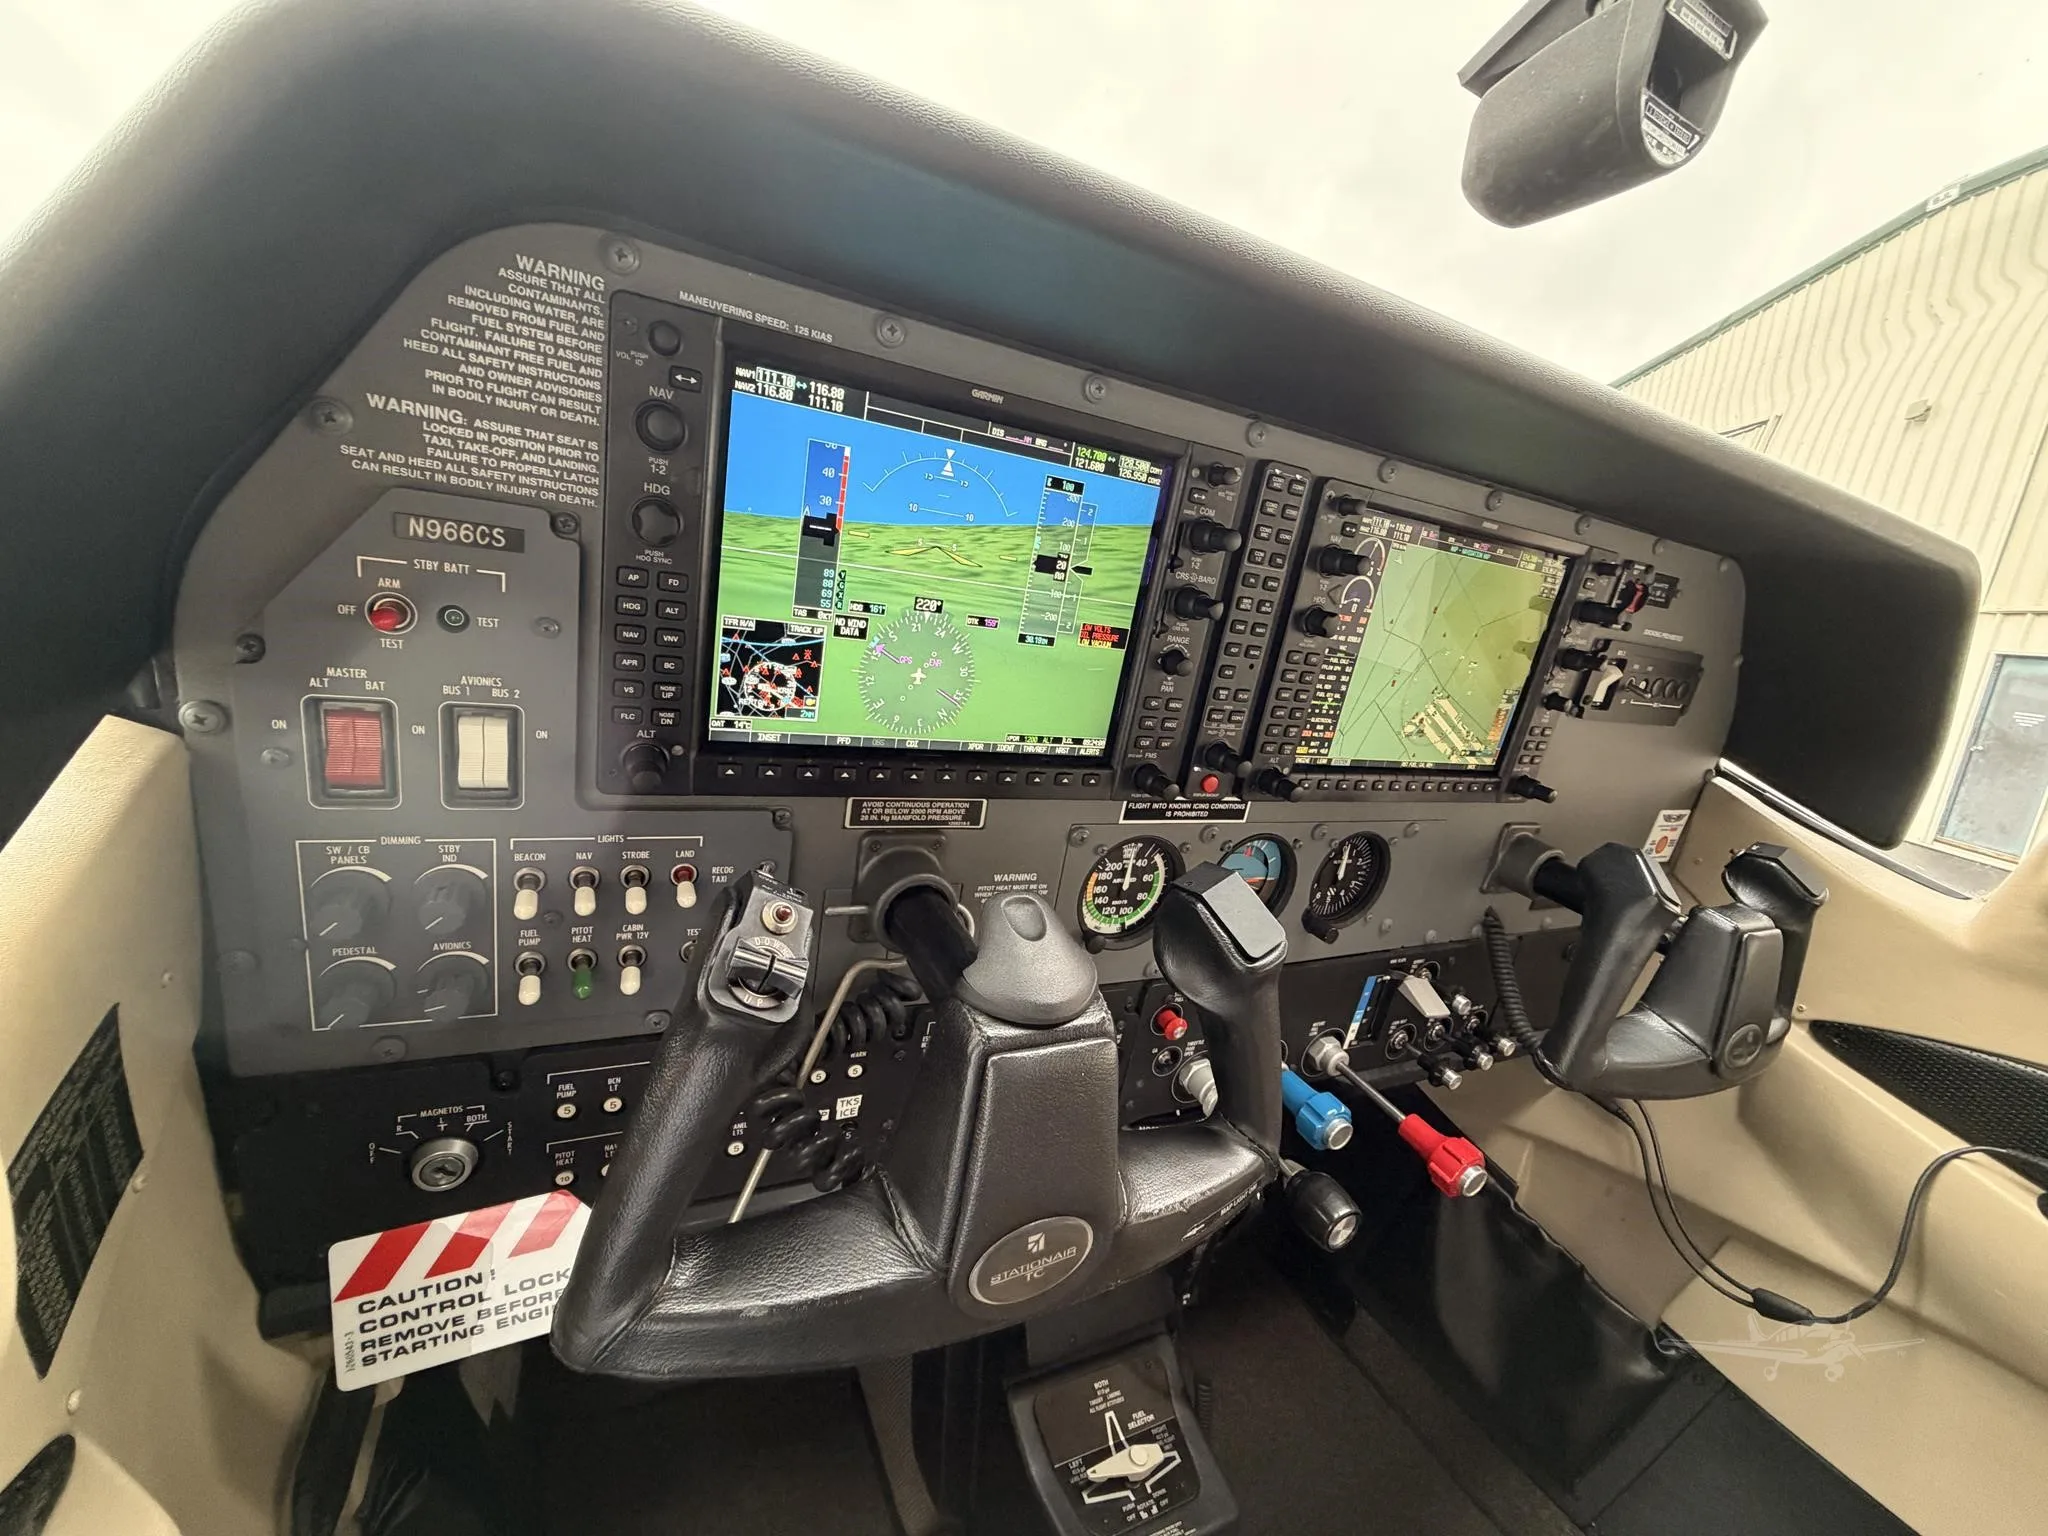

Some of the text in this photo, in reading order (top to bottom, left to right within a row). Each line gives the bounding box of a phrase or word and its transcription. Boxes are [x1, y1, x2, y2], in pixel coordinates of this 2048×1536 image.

[516, 254, 605, 291] WARNING
[499, 268, 604, 302] ASSURE THAT ALL
[465, 285, 604, 329] INCLUDING WATER, ARE
[448, 295, 604, 341] REMOVED FROM FUEL AND
[679, 291, 833, 343] MANEUVERING SPEED: 125 KIAS
[472, 314, 602, 353] FUEL SYSTEM BEFORE
[404, 338, 600, 390] HEED ALL SAFETY INSTRUCTIONS
[757, 369, 844, 399] 111.10 116.80
[650, 386, 674, 400] NAV
[756, 382, 843, 412] 116.80 111.10
[972, 388, 1004, 404] GARMIN
[367, 393, 598, 450] WARNING: ASSURE THAT SEAT IS
[822, 468, 835, 478] 40
[644, 483, 670, 495] HDG
[819, 495, 832, 505] 30
[1200, 508, 1215, 516] COM
[409, 517, 506, 547] N966CS
[414, 559, 469, 574] STBY BATT
[378, 578, 400, 588] ARM
[338, 605, 356, 614] OFF
[794, 608, 807, 617] TAS
[477, 617, 499, 628] TEST
[835, 617, 866, 628] NO WIND
[790, 625, 812, 633] TRACK
[840, 626, 859, 636] DATA
[380, 638, 402, 649] TEST
[1167, 635, 1190, 644] RANGE
[326, 667, 367, 678] MASTER
[309, 678, 384, 690] ALT BAT
[461, 676, 502, 686] AVIONICS
[443, 686, 470, 696] BUS 1
[492, 688, 520, 698] BUS 2
[272, 719, 286, 729] ON
[412, 725, 424, 734] ON
[536, 730, 548, 739] ON
[636, 730, 656, 738] ALT
[758, 734, 781, 742] INSET
[381, 837, 421, 845] DIMMING
[598, 835, 624, 843] LIGHTS
[358, 846, 370, 854] CB
[439, 845, 460, 853] STBY
[676, 850, 695, 858] LAND
[331, 856, 367, 864] PANELS
[514, 853, 545, 861] BEACON
[576, 852, 592, 860] NAV
[622, 851, 650, 859] STROBE
[1105, 863, 1122, 871] 200
[1136, 859, 1147, 867] 40
[712, 875, 727, 883] TAXI
[994, 873, 1037, 881] WARNING
[571, 927, 593, 935] PITOT
[622, 924, 643, 932] CABIN
[572, 935, 592, 943] HEAT
[636, 932, 648, 940] 12V
[433, 942, 471, 951] AVIONICS
[518, 937, 541, 946] PUMP
[332, 947, 377, 956] PEDESTAL
[558, 1084, 574, 1092] FUEL
[556, 1091, 576, 1099] PUMP
[839, 1097, 859, 1107] TKS
[420, 1106, 463, 1117] MAGNETOS
[839, 1107, 856, 1117] ICE
[466, 1113, 487, 1122] BOTH
[990, 1246, 1077, 1286] STATIONAIR
[1026, 1270, 1044, 1281] TC
[359, 1267, 570, 1334] CONTROL LOCK
[361, 1314, 465, 1352] REMOVE
[361, 1325, 484, 1367] STARTING
[497, 1305, 555, 1330] ENGI
[1094, 1379, 1108, 1389] BOTH
[1133, 1410, 1146, 1420] FUEL
[1128, 1414, 1155, 1430] SELECTOR
